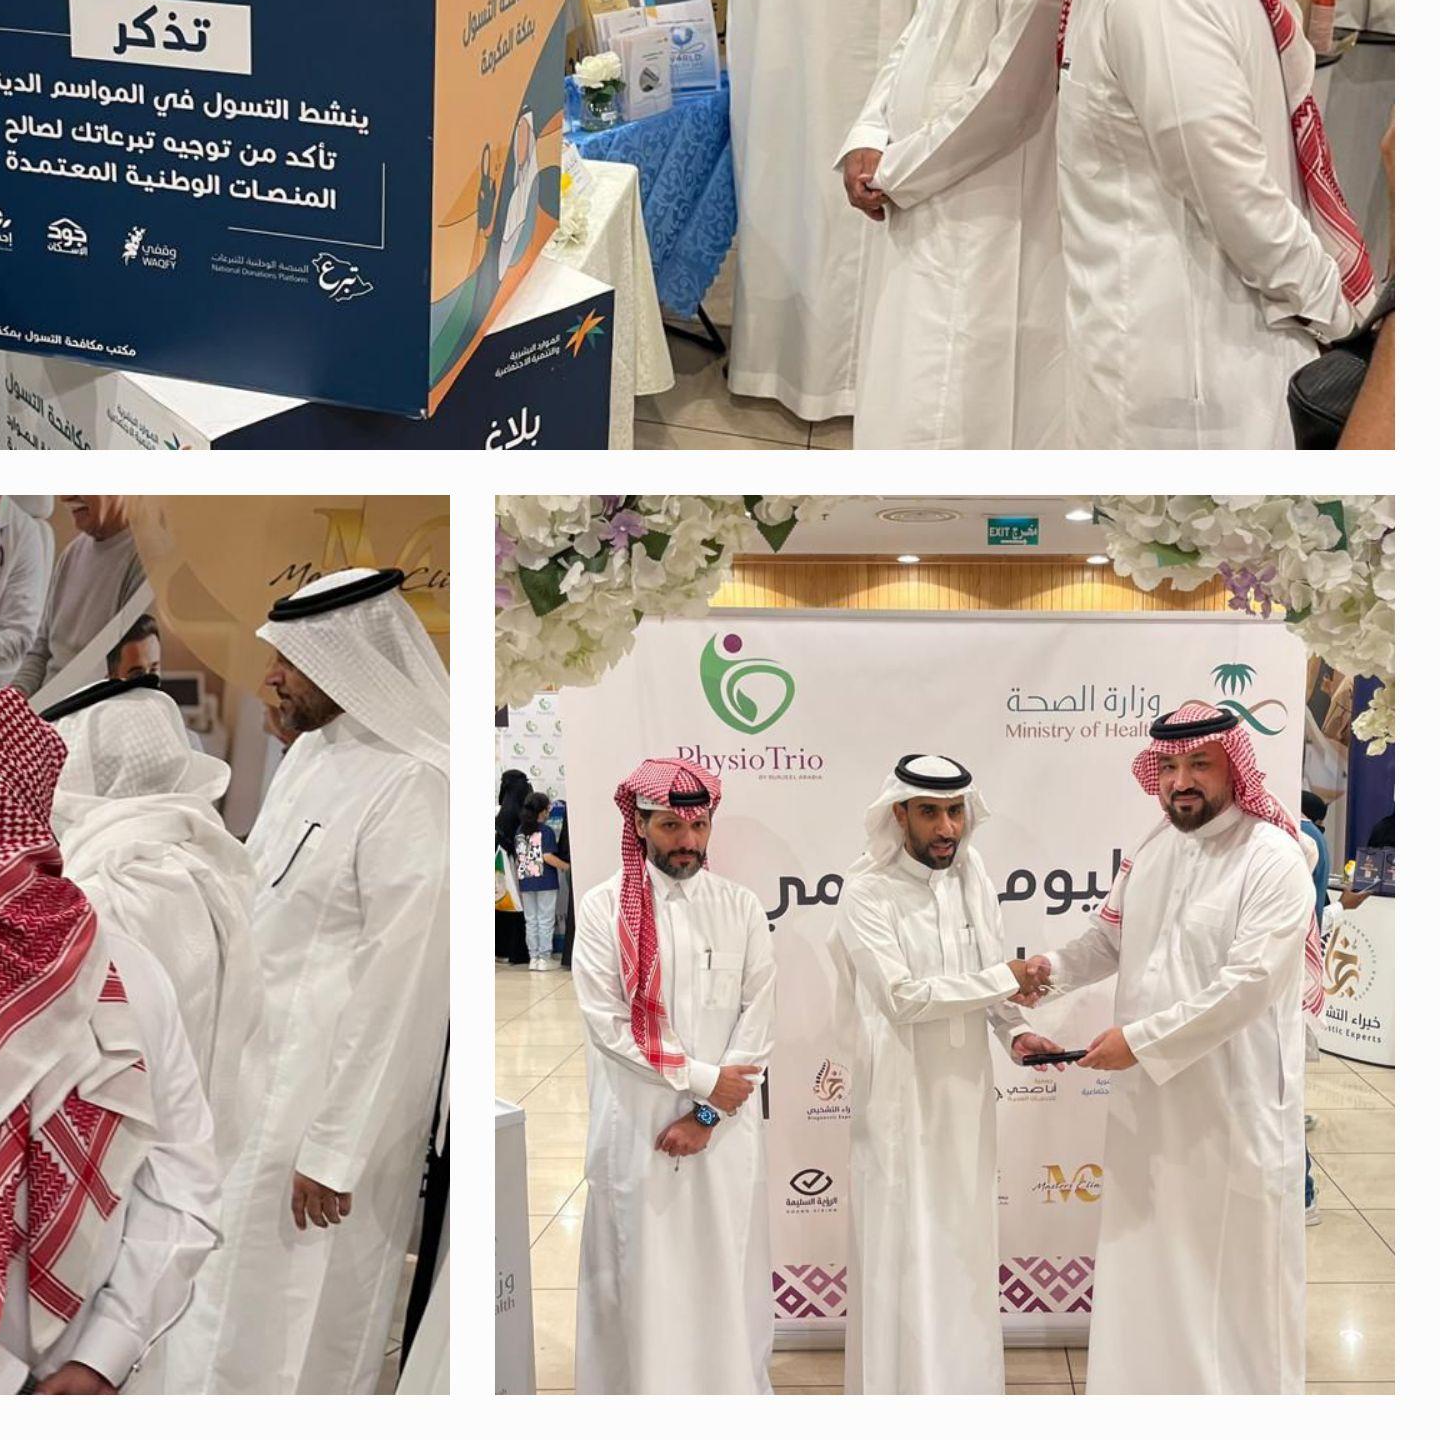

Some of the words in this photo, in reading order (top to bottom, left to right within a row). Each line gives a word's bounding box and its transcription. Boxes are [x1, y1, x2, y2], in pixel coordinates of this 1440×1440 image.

[113, 4, 212, 55] تذكر
[515, 14, 536, 46] بمكة
[480, 29, 514, 76] المكرمة
[49, 73, 145, 108] المواسم
[153, 86, 194, 118] في
[202, 90, 289, 123] التسول
[298, 101, 370, 135] ينشط
[5, 117, 64, 143] لصالح
[70, 122, 155, 153] تبرعاتك
[162, 137, 232, 162] توجيه
[238, 143, 277, 167] من
[285, 141, 338, 172] تأكد
[6, 151, 118, 185] المعتمدة
[124, 166, 221, 198] الوطنية
[229, 178, 338, 211] المنصات
[47, 224, 88, 248] جود
[141, 243, 177, 259] وقفي
[142, 257, 177, 271] WAQFY
[318, 260, 359, 299] تبرع
[25, 330, 62, 345] التسول
[64, 336, 104, 352] مكافحة
[106, 343, 136, 357] مكتب
[5, 372, 45, 412] التسول
[989, 526, 1009, 537] EXIT
[1006, 684, 1095, 713] الصحة
[1103, 684, 1161, 719] وزارة
[1005, 721, 1076, 742] Ministry
[1083, 721, 1102, 738] of
[1105, 721, 1151, 738] Healt
[677, 744, 824, 778] PhysioTrio
[997, 848, 1122, 916] ليوم
[1345, 1028, 1382, 1044] Experts
[1351, 1012, 1381, 1031] خبراء
